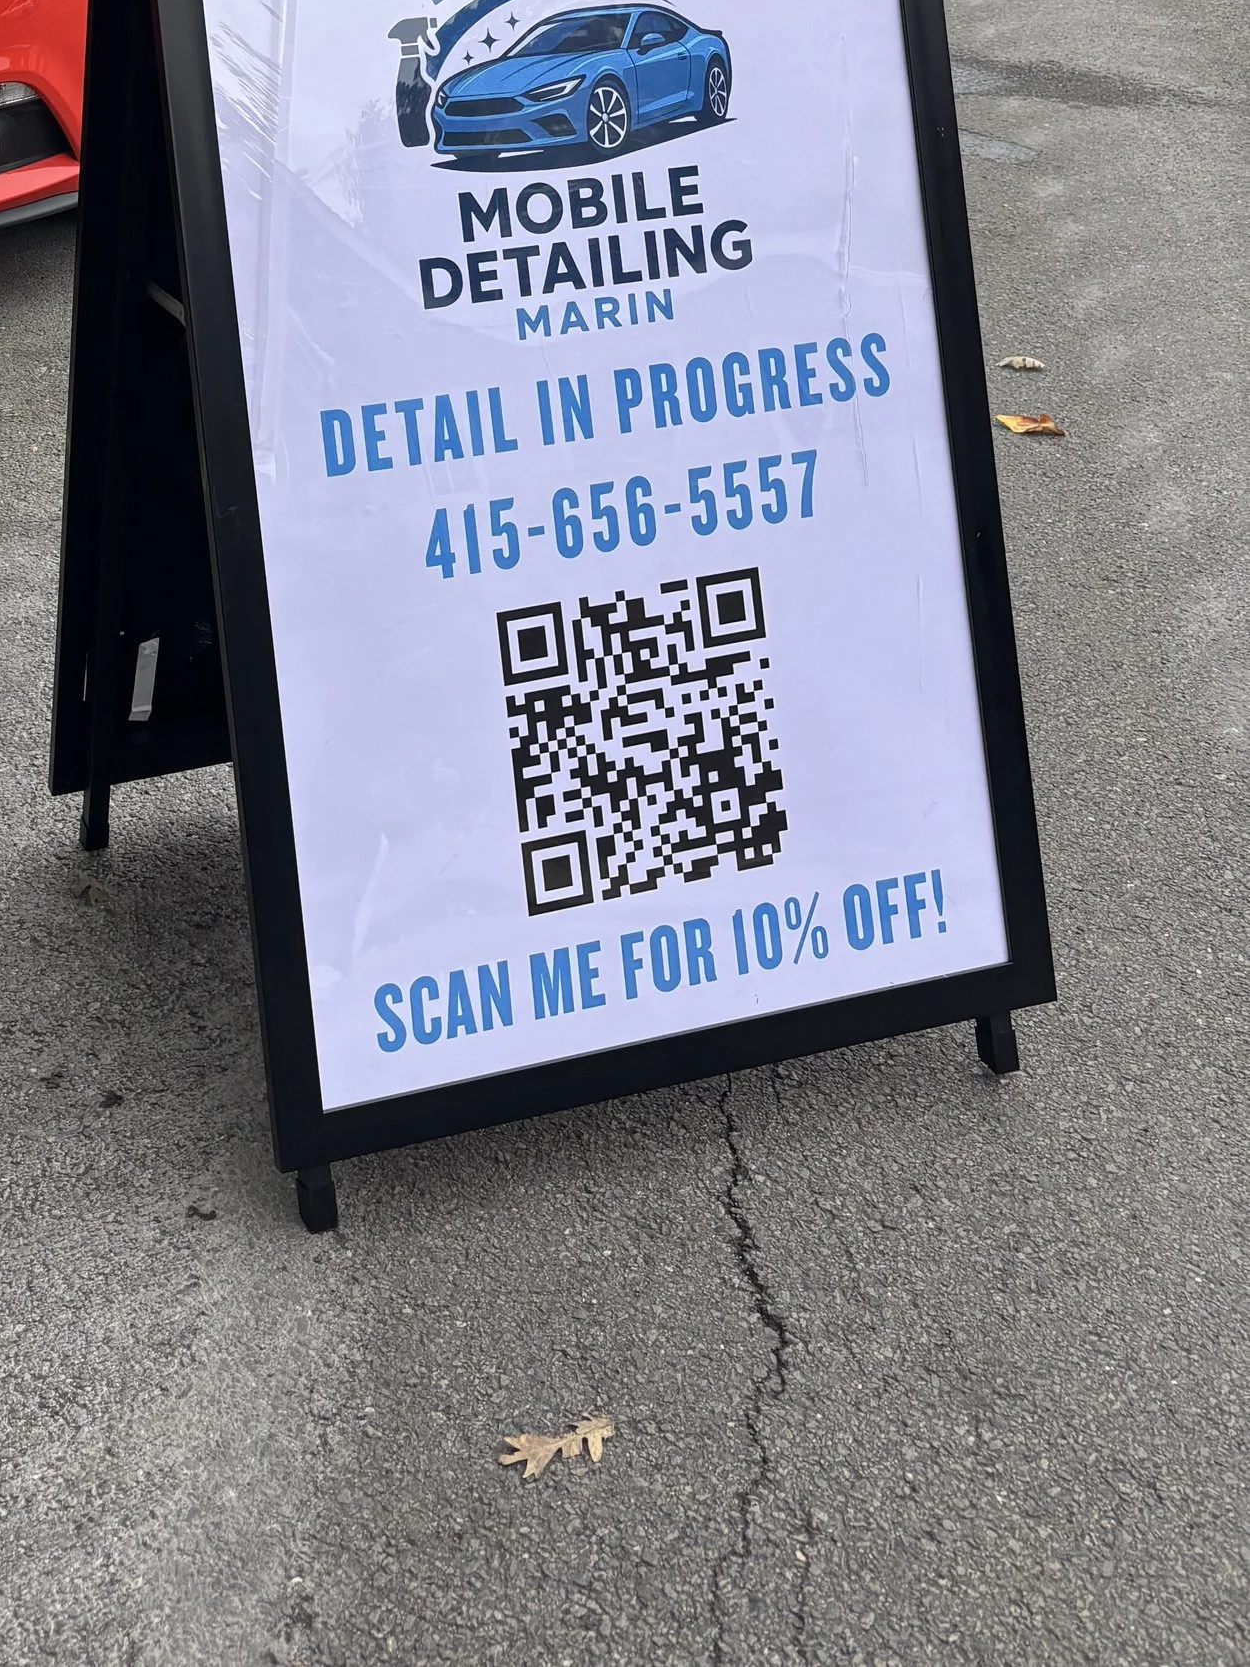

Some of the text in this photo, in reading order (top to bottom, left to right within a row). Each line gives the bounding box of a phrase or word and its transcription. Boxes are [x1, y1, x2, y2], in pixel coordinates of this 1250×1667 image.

[458, 165, 704, 242] MOBILE
[419, 219, 753, 310] DETAILING
[515, 288, 675, 341] MARIN
[320, 332, 891, 477] DETAIL IN PROGRESS
[424, 449, 819, 579] 415-656-5557
[374, 868, 948, 1053] SCAN ME FOR 10% OFF!
